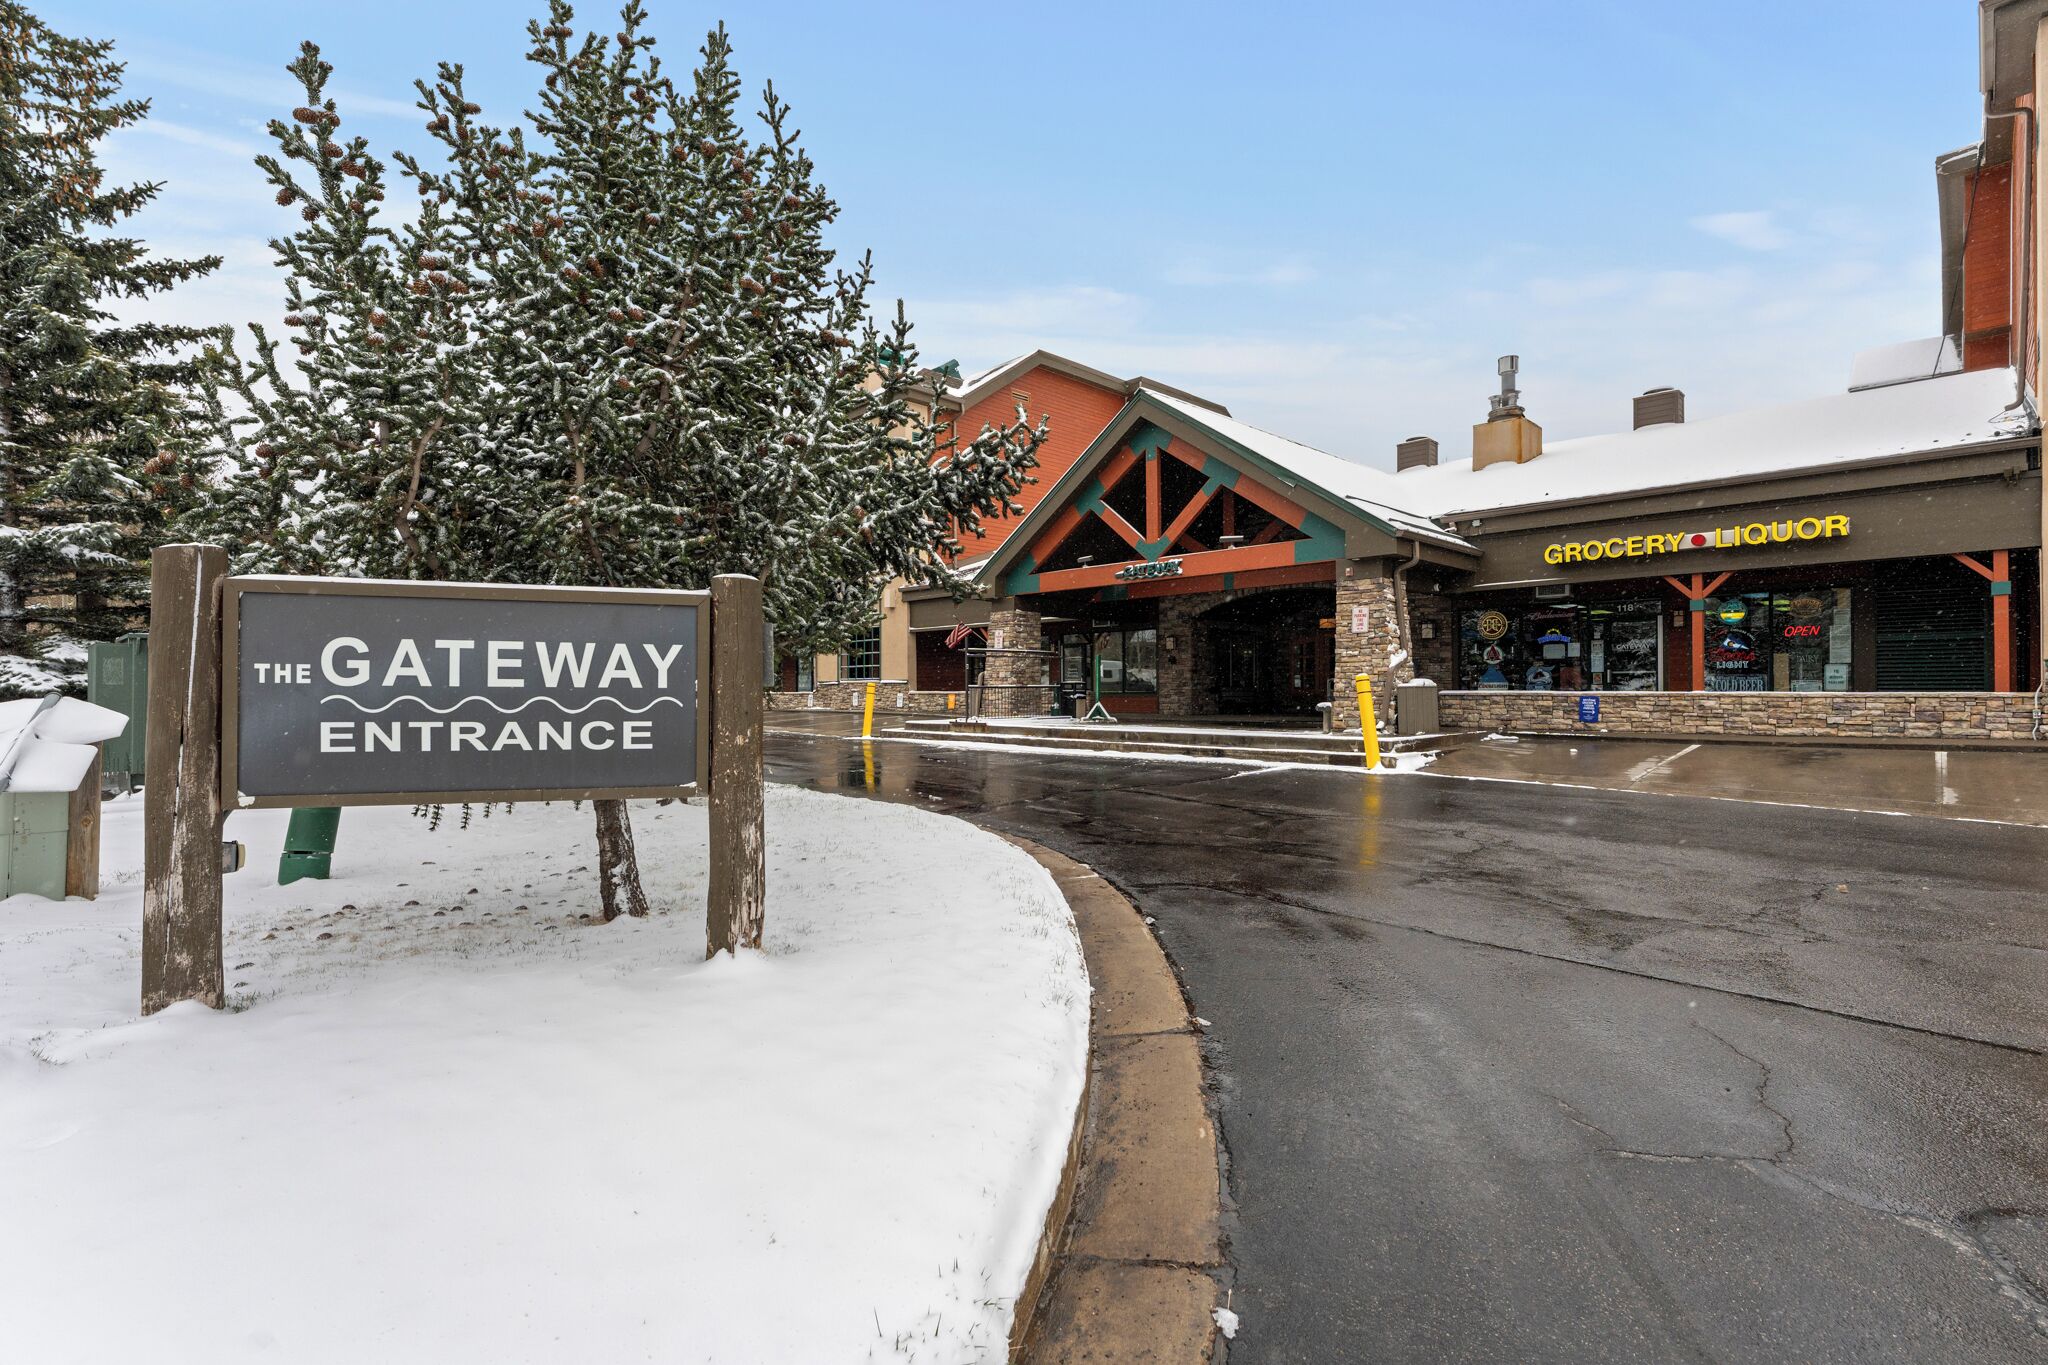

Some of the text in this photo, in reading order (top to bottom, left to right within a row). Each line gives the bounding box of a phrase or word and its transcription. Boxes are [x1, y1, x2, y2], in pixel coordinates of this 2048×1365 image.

[1543, 515, 1849, 566] GROCERY LIQUOR
[1122, 559, 1183, 577] GATEWAY
[1616, 603, 1635, 612] 118
[1784, 625, 1822, 637] OPEN
[254, 636, 683, 690] THE GATEWAY
[1716, 660, 1749, 669] LIGHT
[1715, 679, 1764, 691] COLD BEER
[319, 720, 654, 753] ENTRANCE
